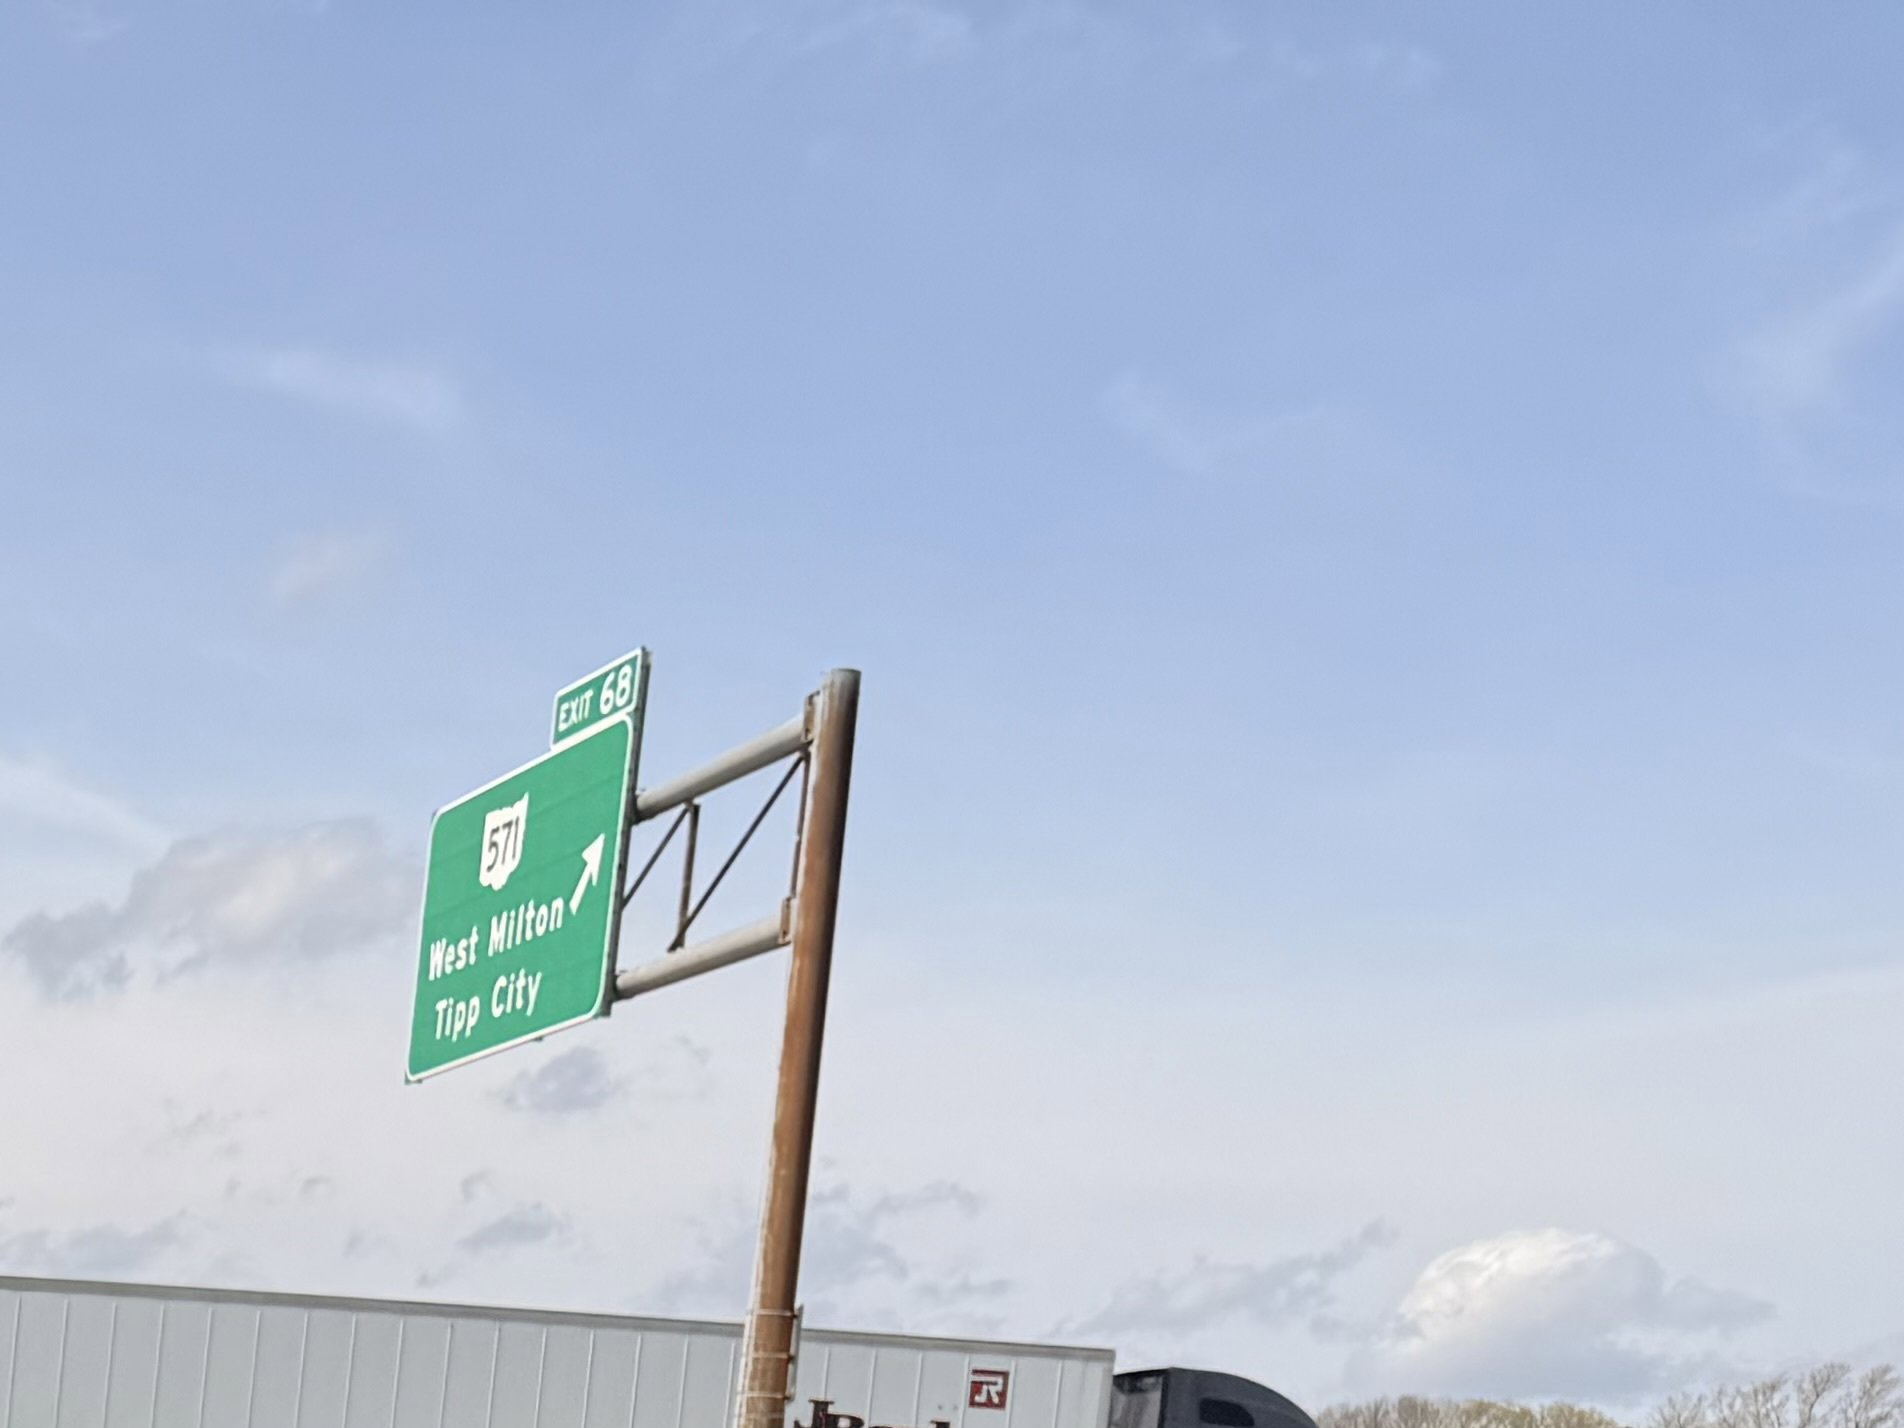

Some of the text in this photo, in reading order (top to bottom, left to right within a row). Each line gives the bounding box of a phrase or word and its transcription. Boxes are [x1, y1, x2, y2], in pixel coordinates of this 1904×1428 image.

[558, 664, 632, 732] EXIT 68
[486, 815, 521, 873] 571
[429, 897, 564, 981] West Milton
[435, 971, 542, 1042] Tipp City
